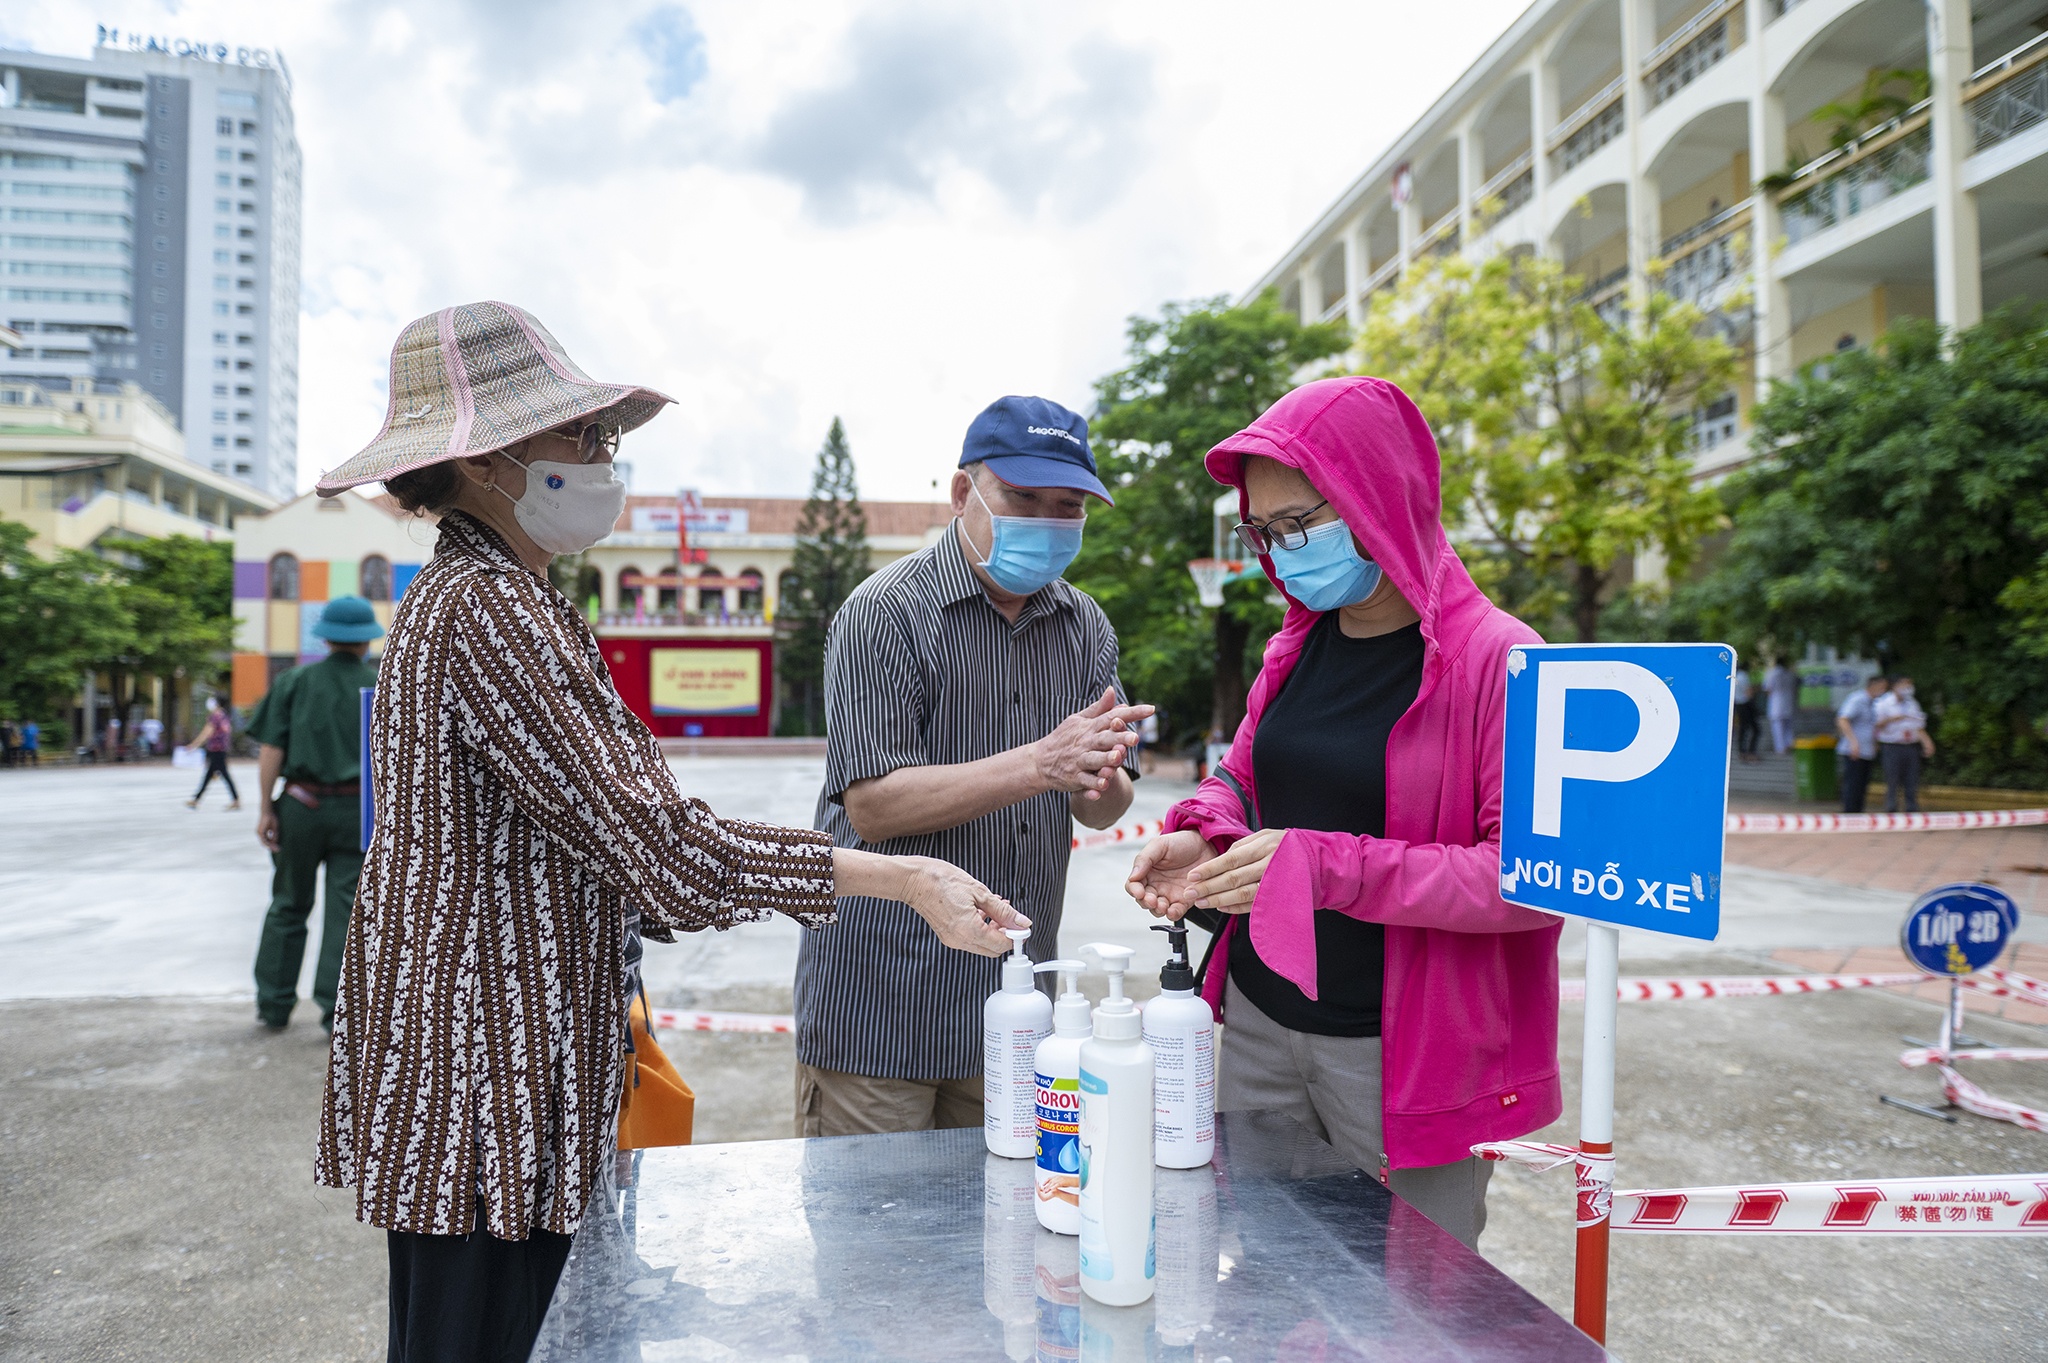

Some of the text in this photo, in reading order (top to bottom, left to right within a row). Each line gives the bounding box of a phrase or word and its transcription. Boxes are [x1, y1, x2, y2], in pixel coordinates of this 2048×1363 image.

[1532, 660, 1681, 838] P
[1514, 857, 1691, 914] NƠI ĐỖ XE
[1917, 903, 2000, 947] LỚP 2B
[1040, 1119, 1055, 1131] VIRUS
